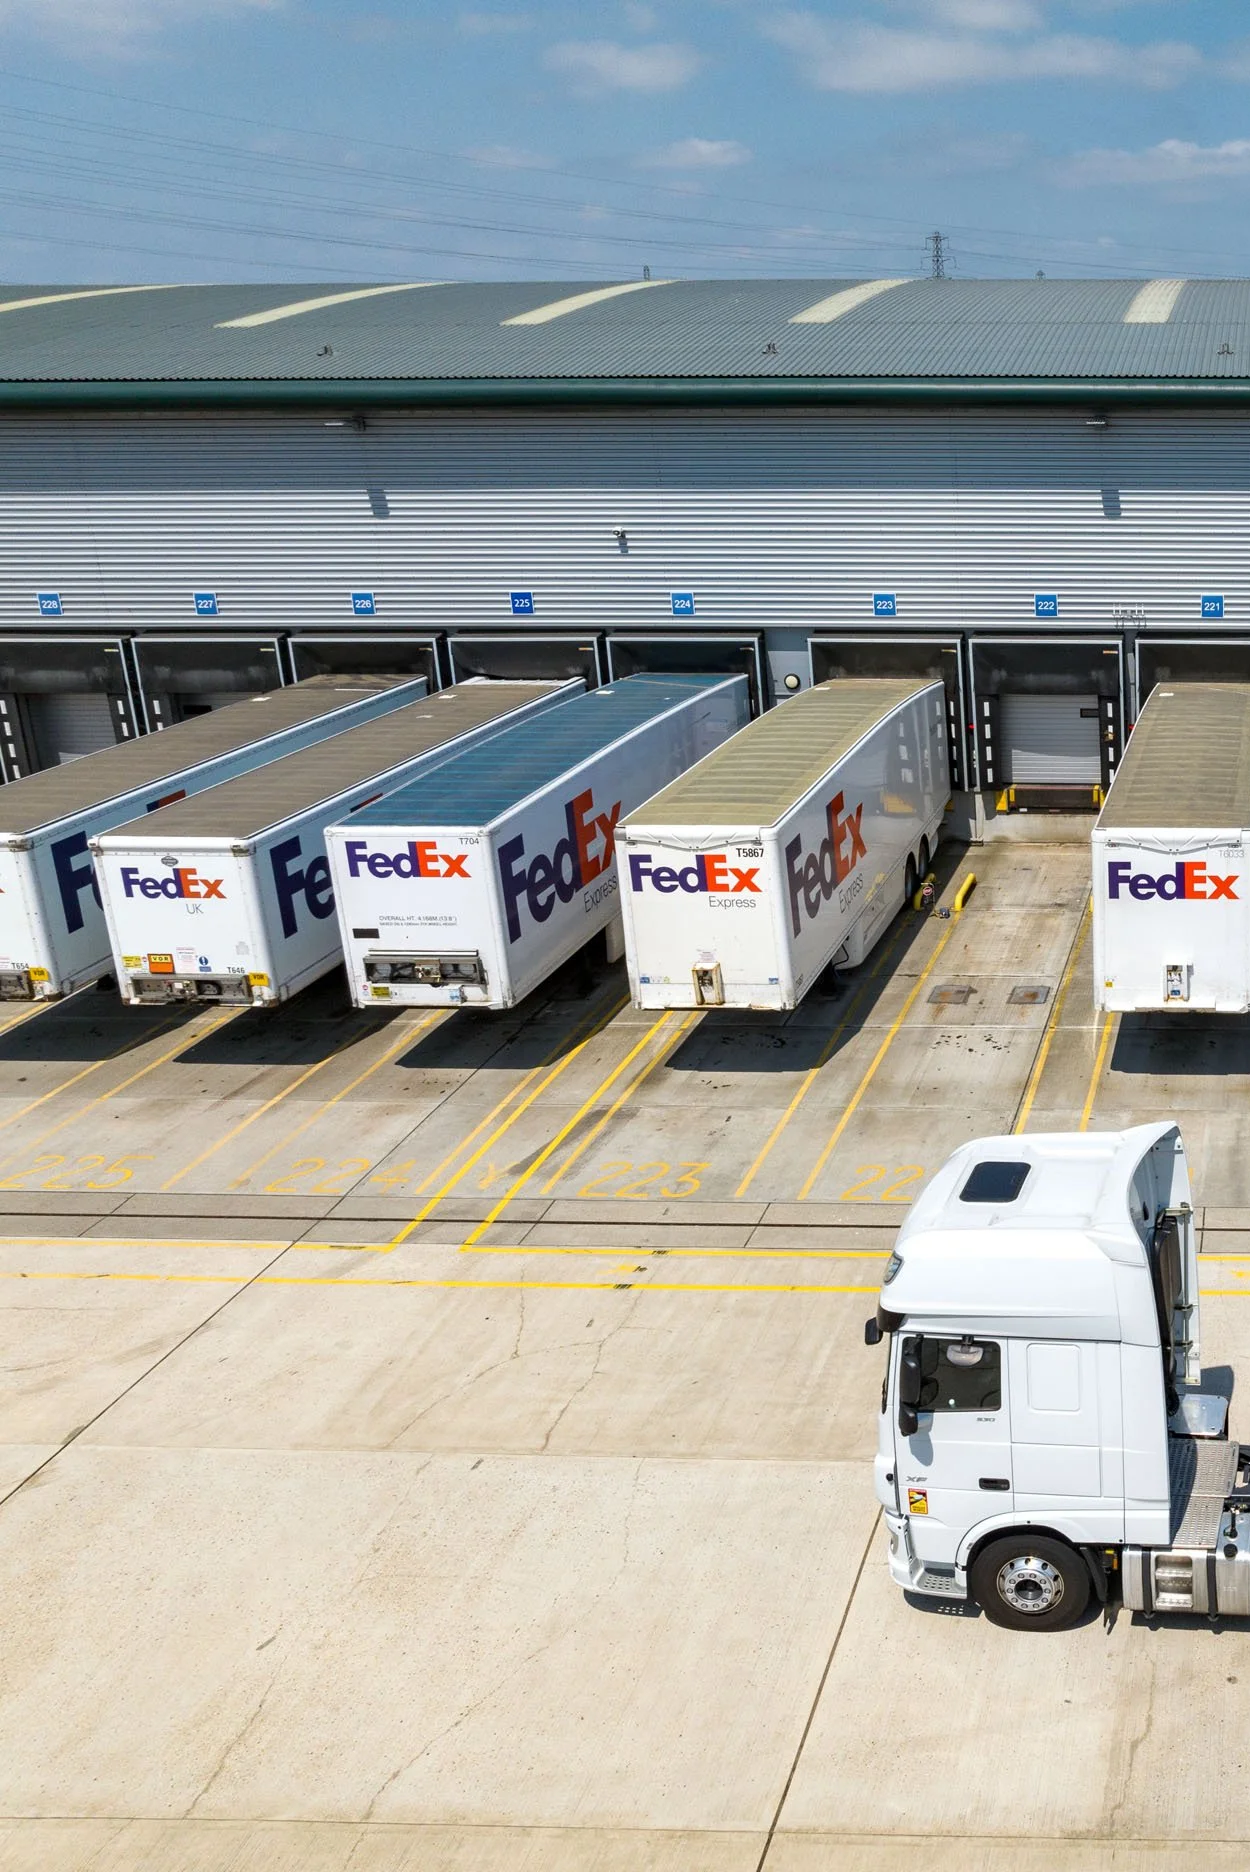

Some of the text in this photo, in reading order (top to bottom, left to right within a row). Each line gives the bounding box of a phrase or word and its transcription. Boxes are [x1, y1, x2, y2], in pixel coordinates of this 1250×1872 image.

[41, 600, 58, 609] 228
[197, 600, 214, 608] 227
[355, 600, 371, 608] 226
[514, 599, 530, 607] 225
[674, 600, 691, 608] 224
[877, 601, 893, 609] 223
[1038, 601, 1054, 610] 222
[1204, 602, 1219, 611] 221
[459, 837, 480, 845] T704
[736, 848, 764, 858] T5867
[344, 841, 472, 878] FedEx
[785, 790, 867, 939] FedEx
[498, 788, 621, 944] FedEx
[628, 854, 763, 893] FedEx
[120, 867, 227, 899] FedEx
[1107, 861, 1240, 901] FedEx
[583, 875, 618, 913] Express
[838, 873, 864, 914] Express
[709, 896, 757, 910] Express
[186, 904, 204, 915] UK
[11, 962, 30, 970] T654
[227, 966, 246, 974] T646
[0, 1154, 156, 1189] 225
[264, 1157, 417, 1195] 224
[577, 1161, 711, 1198] 223
[840, 1164, 938, 1201] 22
